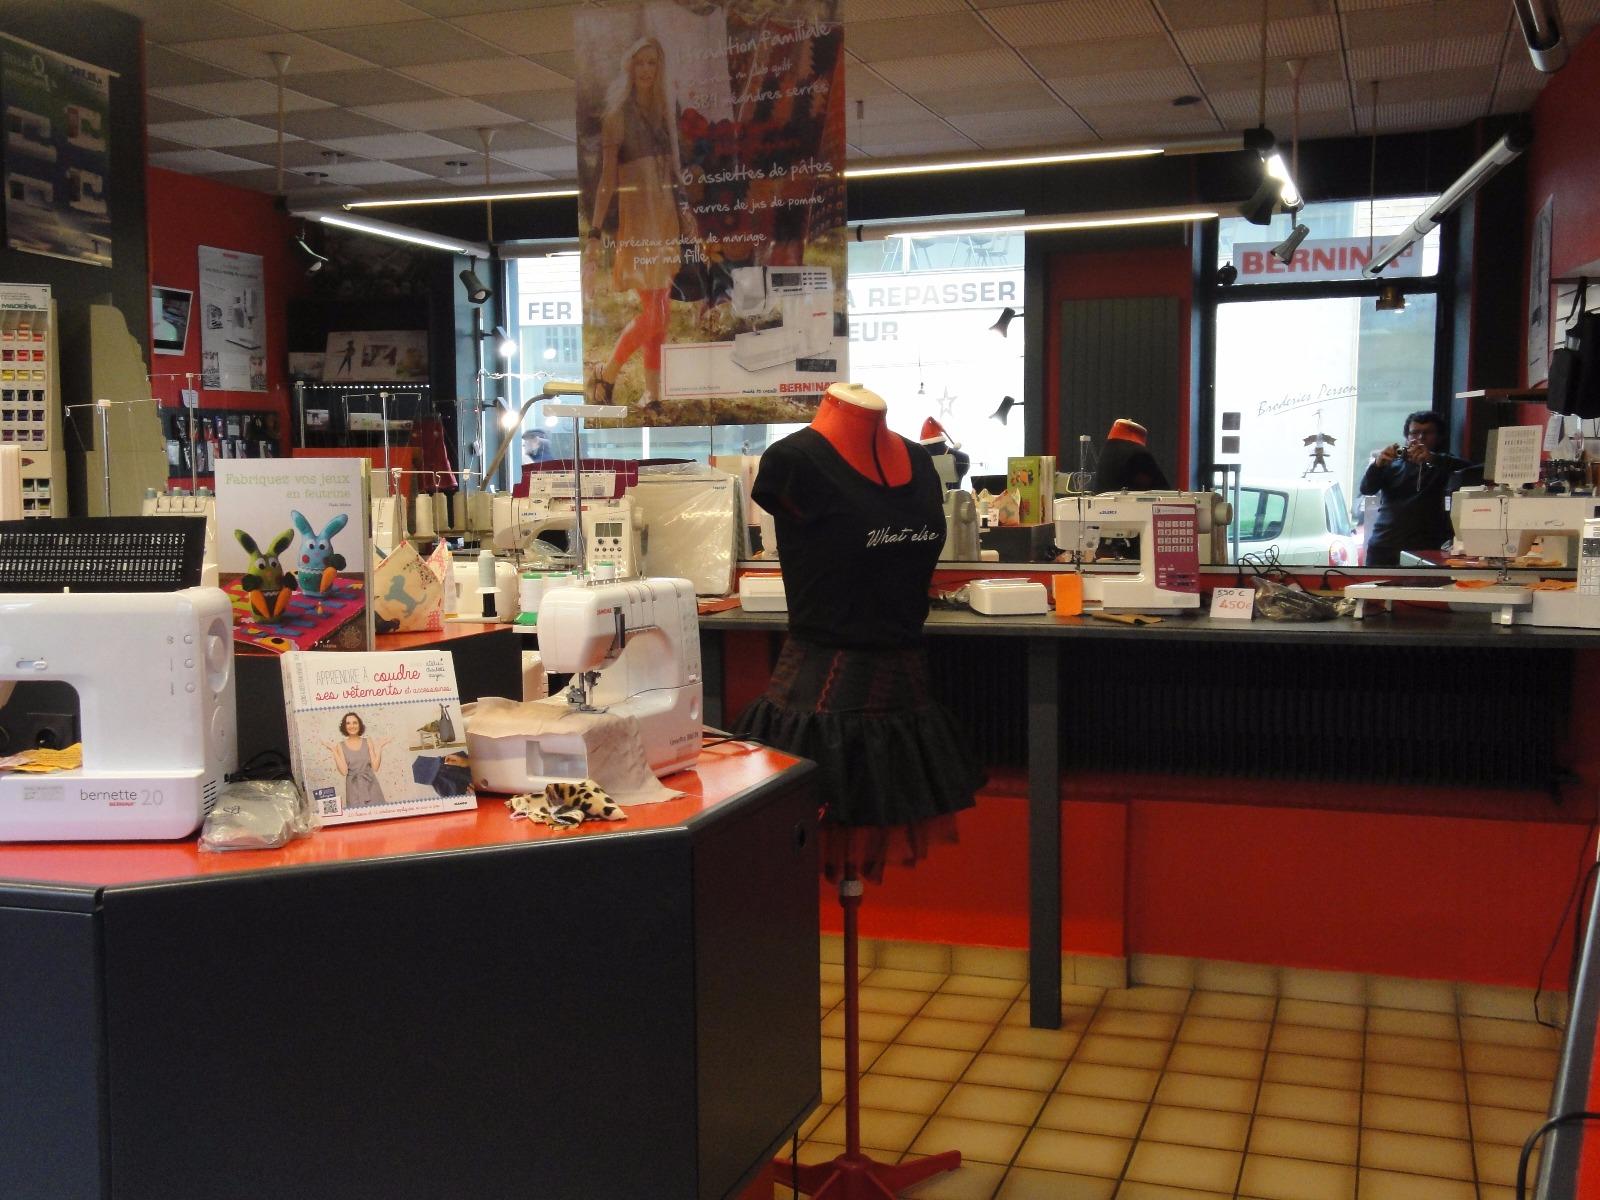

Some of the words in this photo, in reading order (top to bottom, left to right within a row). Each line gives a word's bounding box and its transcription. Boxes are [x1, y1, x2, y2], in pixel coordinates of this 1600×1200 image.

[760, 15, 832, 49] familiale
[682, 169, 694, 185] 6
[697, 165, 765, 184] assiettes
[769, 161, 788, 177] de
[791, 156, 834, 181] pâtes
[680, 202, 690, 216] 7
[693, 202, 731, 214] verres
[734, 199, 748, 211] de
[750, 199, 767, 214] jus
[770, 195, 785, 207] de
[788, 197, 825, 210] pomme
[601, 236, 616, 249] Un
[706, 232, 720, 243] de
[722, 231, 768, 247] mariage
[633, 256, 657, 271] pour
[663, 254, 682, 264] ma
[868, 281, 1016, 308] REPASSER
[528, 301, 572, 320] FER
[225, 473, 290, 486] Fabriquez
[294, 474, 317, 485] vos
[319, 472, 351, 487] jeux
[286, 491, 301, 499] en
[304, 488, 351, 499] feutrine
[866, 526, 913, 549] What
[911, 524, 940, 542] else
[316, 667, 361, 687] APPRENDRE
[373, 663, 421, 684] coudre
[315, 691, 339, 701] ses
[342, 683, 403, 699] vêtements
[412, 685, 452, 694] accessoires
[80, 789, 137, 801] bernette
[141, 789, 164, 806] 20
